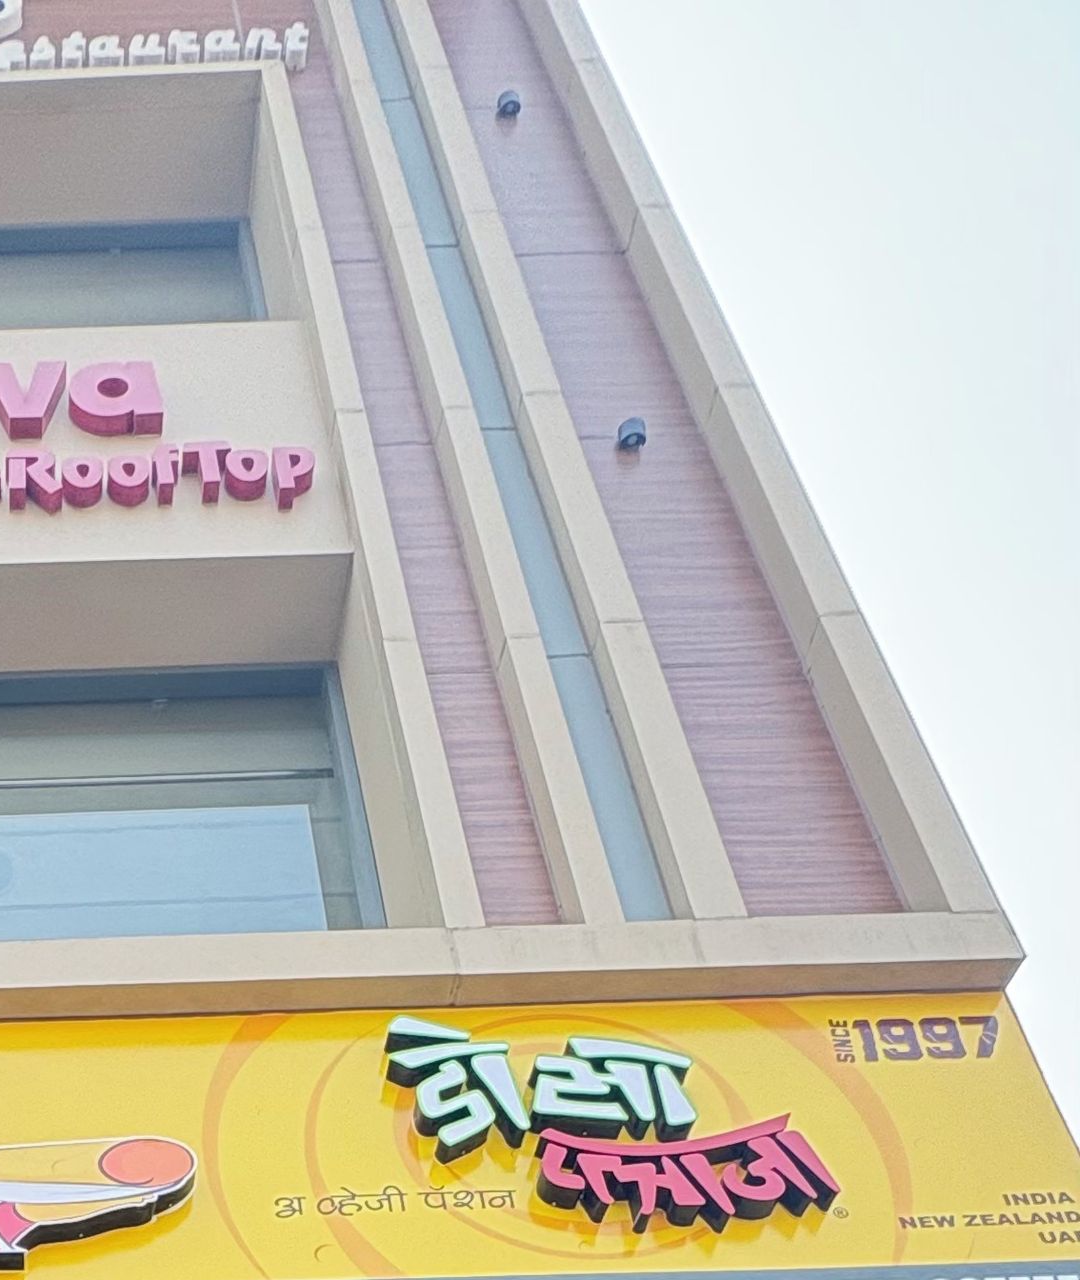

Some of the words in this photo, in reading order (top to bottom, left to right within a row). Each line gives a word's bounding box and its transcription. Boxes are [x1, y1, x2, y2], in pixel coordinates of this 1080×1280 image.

[828, 1018, 856, 1063] SINCE
[851, 1015, 999, 1063] 1997
[384, 1014, 698, 1166] डोसा
[1002, 1191, 1076, 1206] INDIA
[898, 1215, 956, 1229] NEW
[964, 1210, 1080, 1226] ZEALAND
